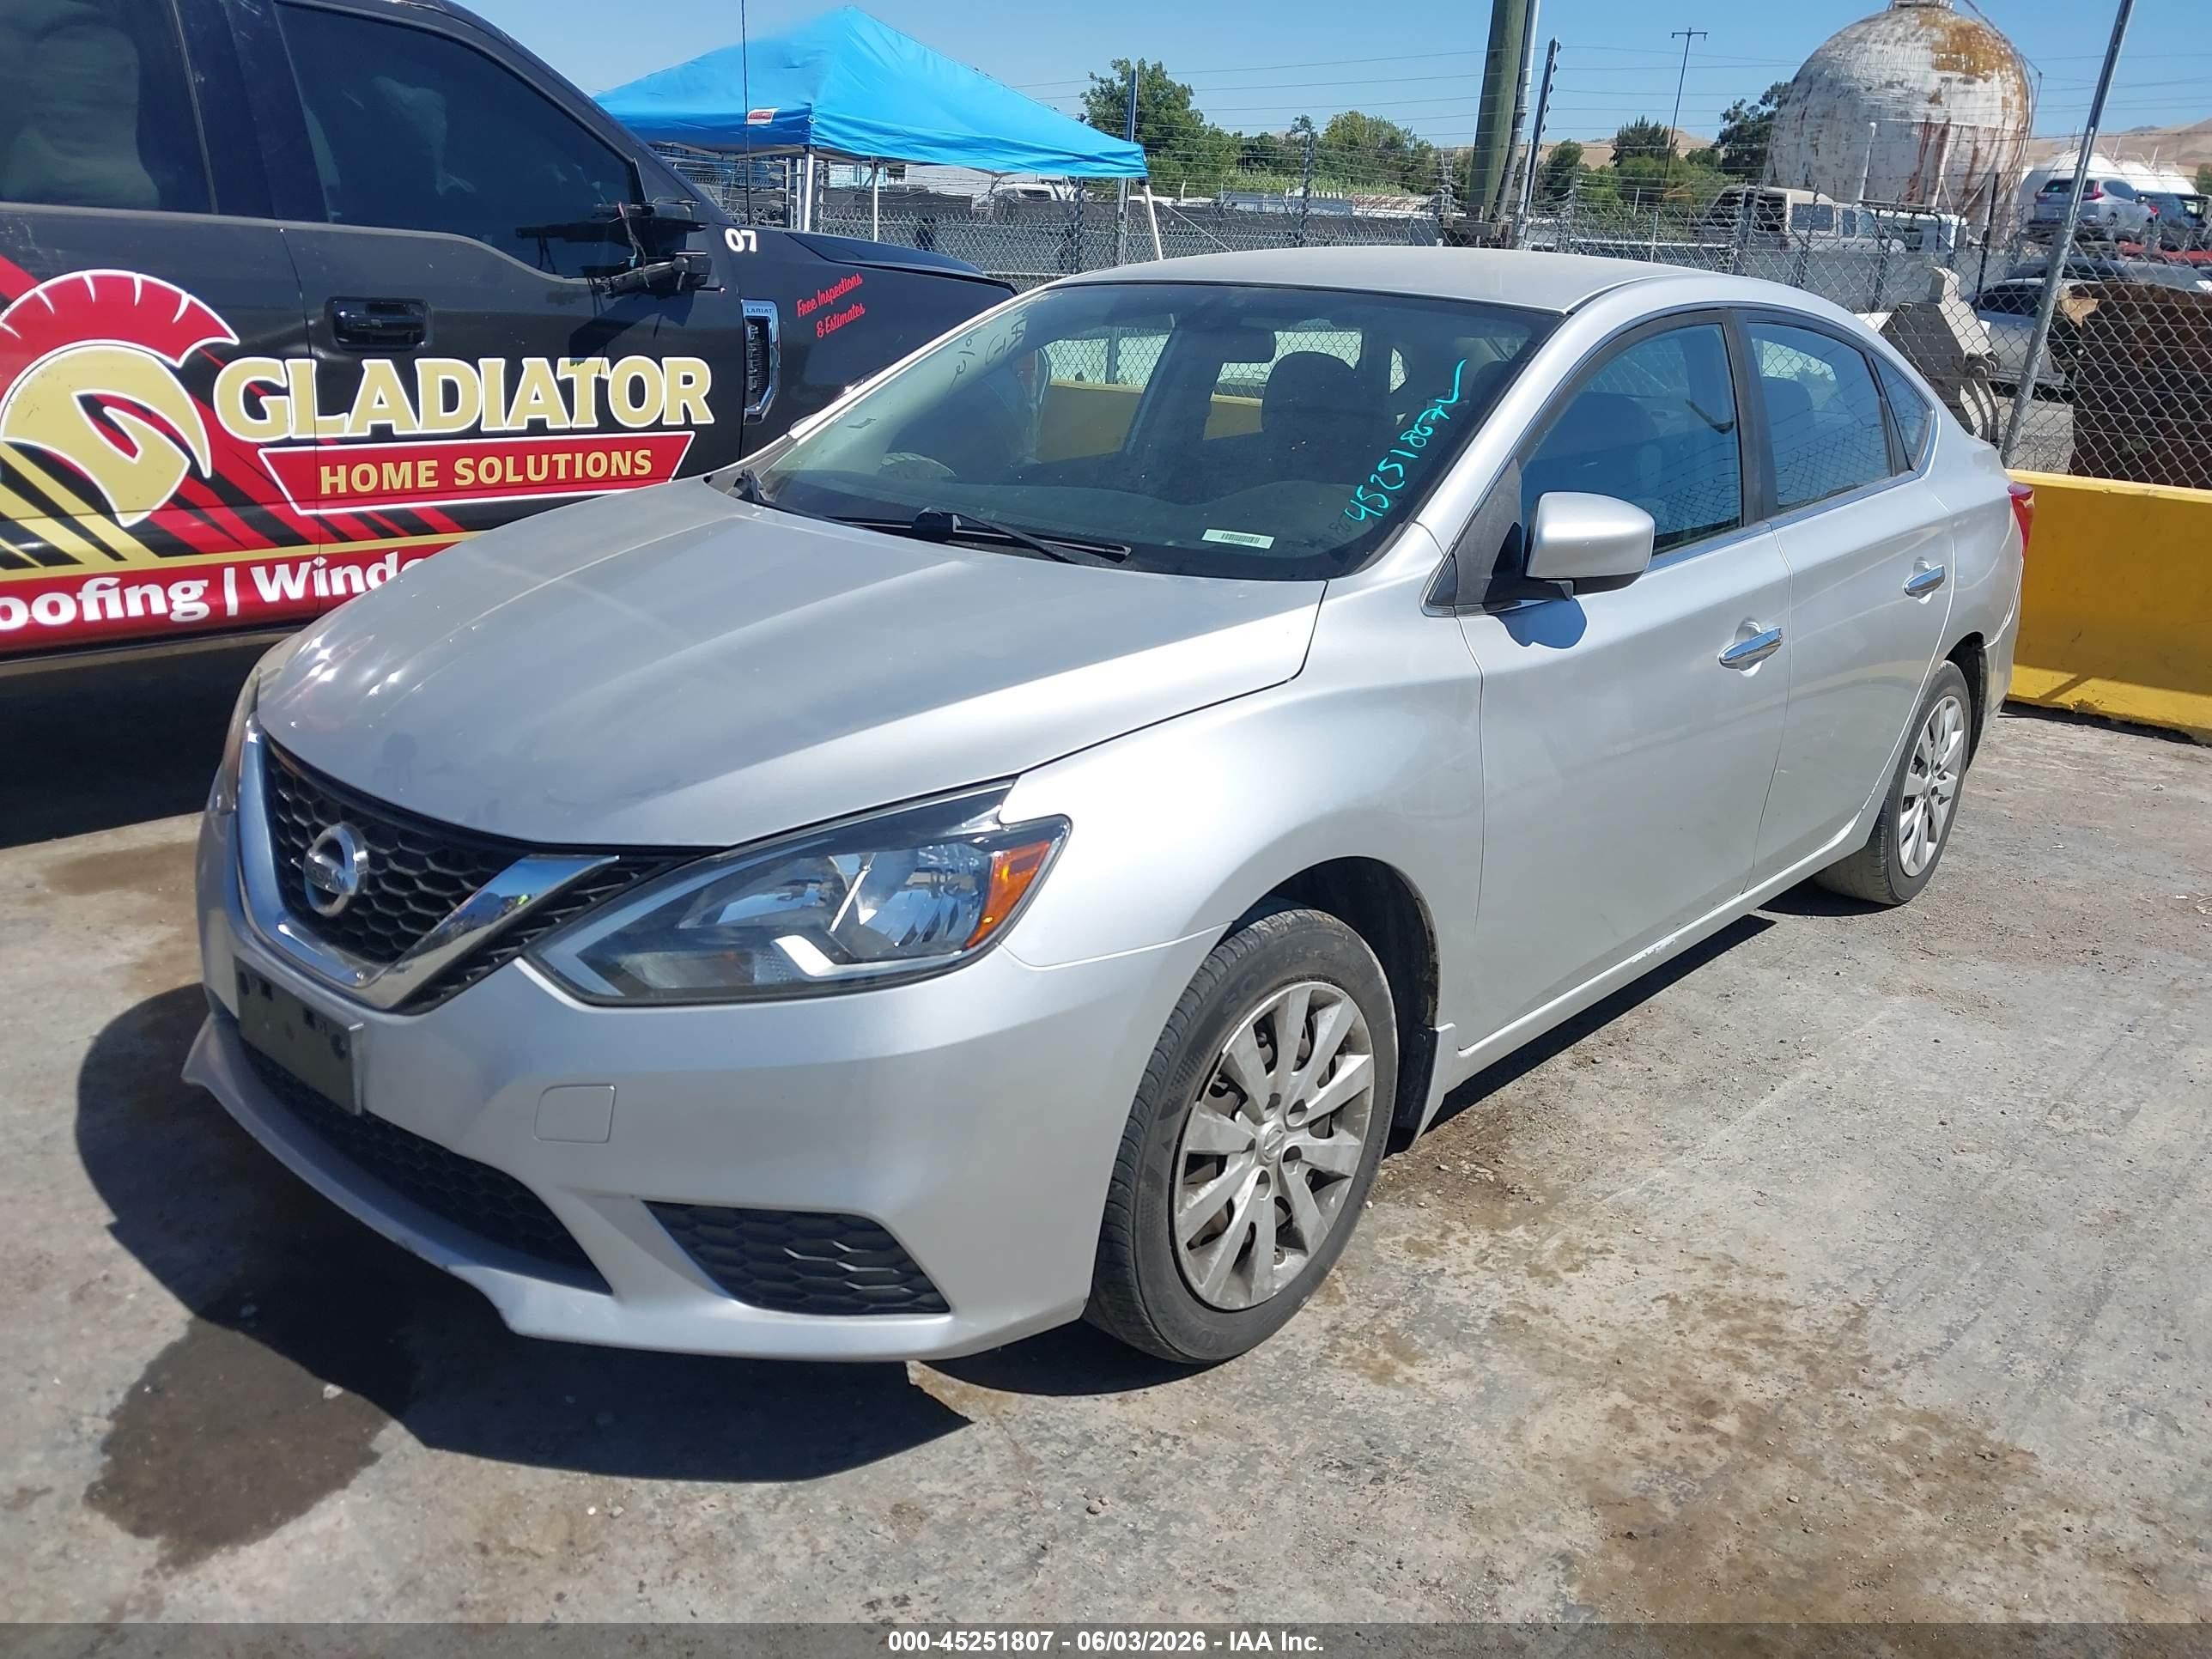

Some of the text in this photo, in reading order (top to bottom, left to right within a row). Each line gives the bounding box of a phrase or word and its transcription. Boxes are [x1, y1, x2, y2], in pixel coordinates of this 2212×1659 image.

[725, 228, 757, 252] 07
[796, 272, 863, 318] Free Inspections
[824, 302, 866, 334] Estimates
[213, 356, 715, 442] GLADIATOR
[320, 449, 653, 495] HOME SOLUTIONS
[249, 551, 425, 603] Wind
